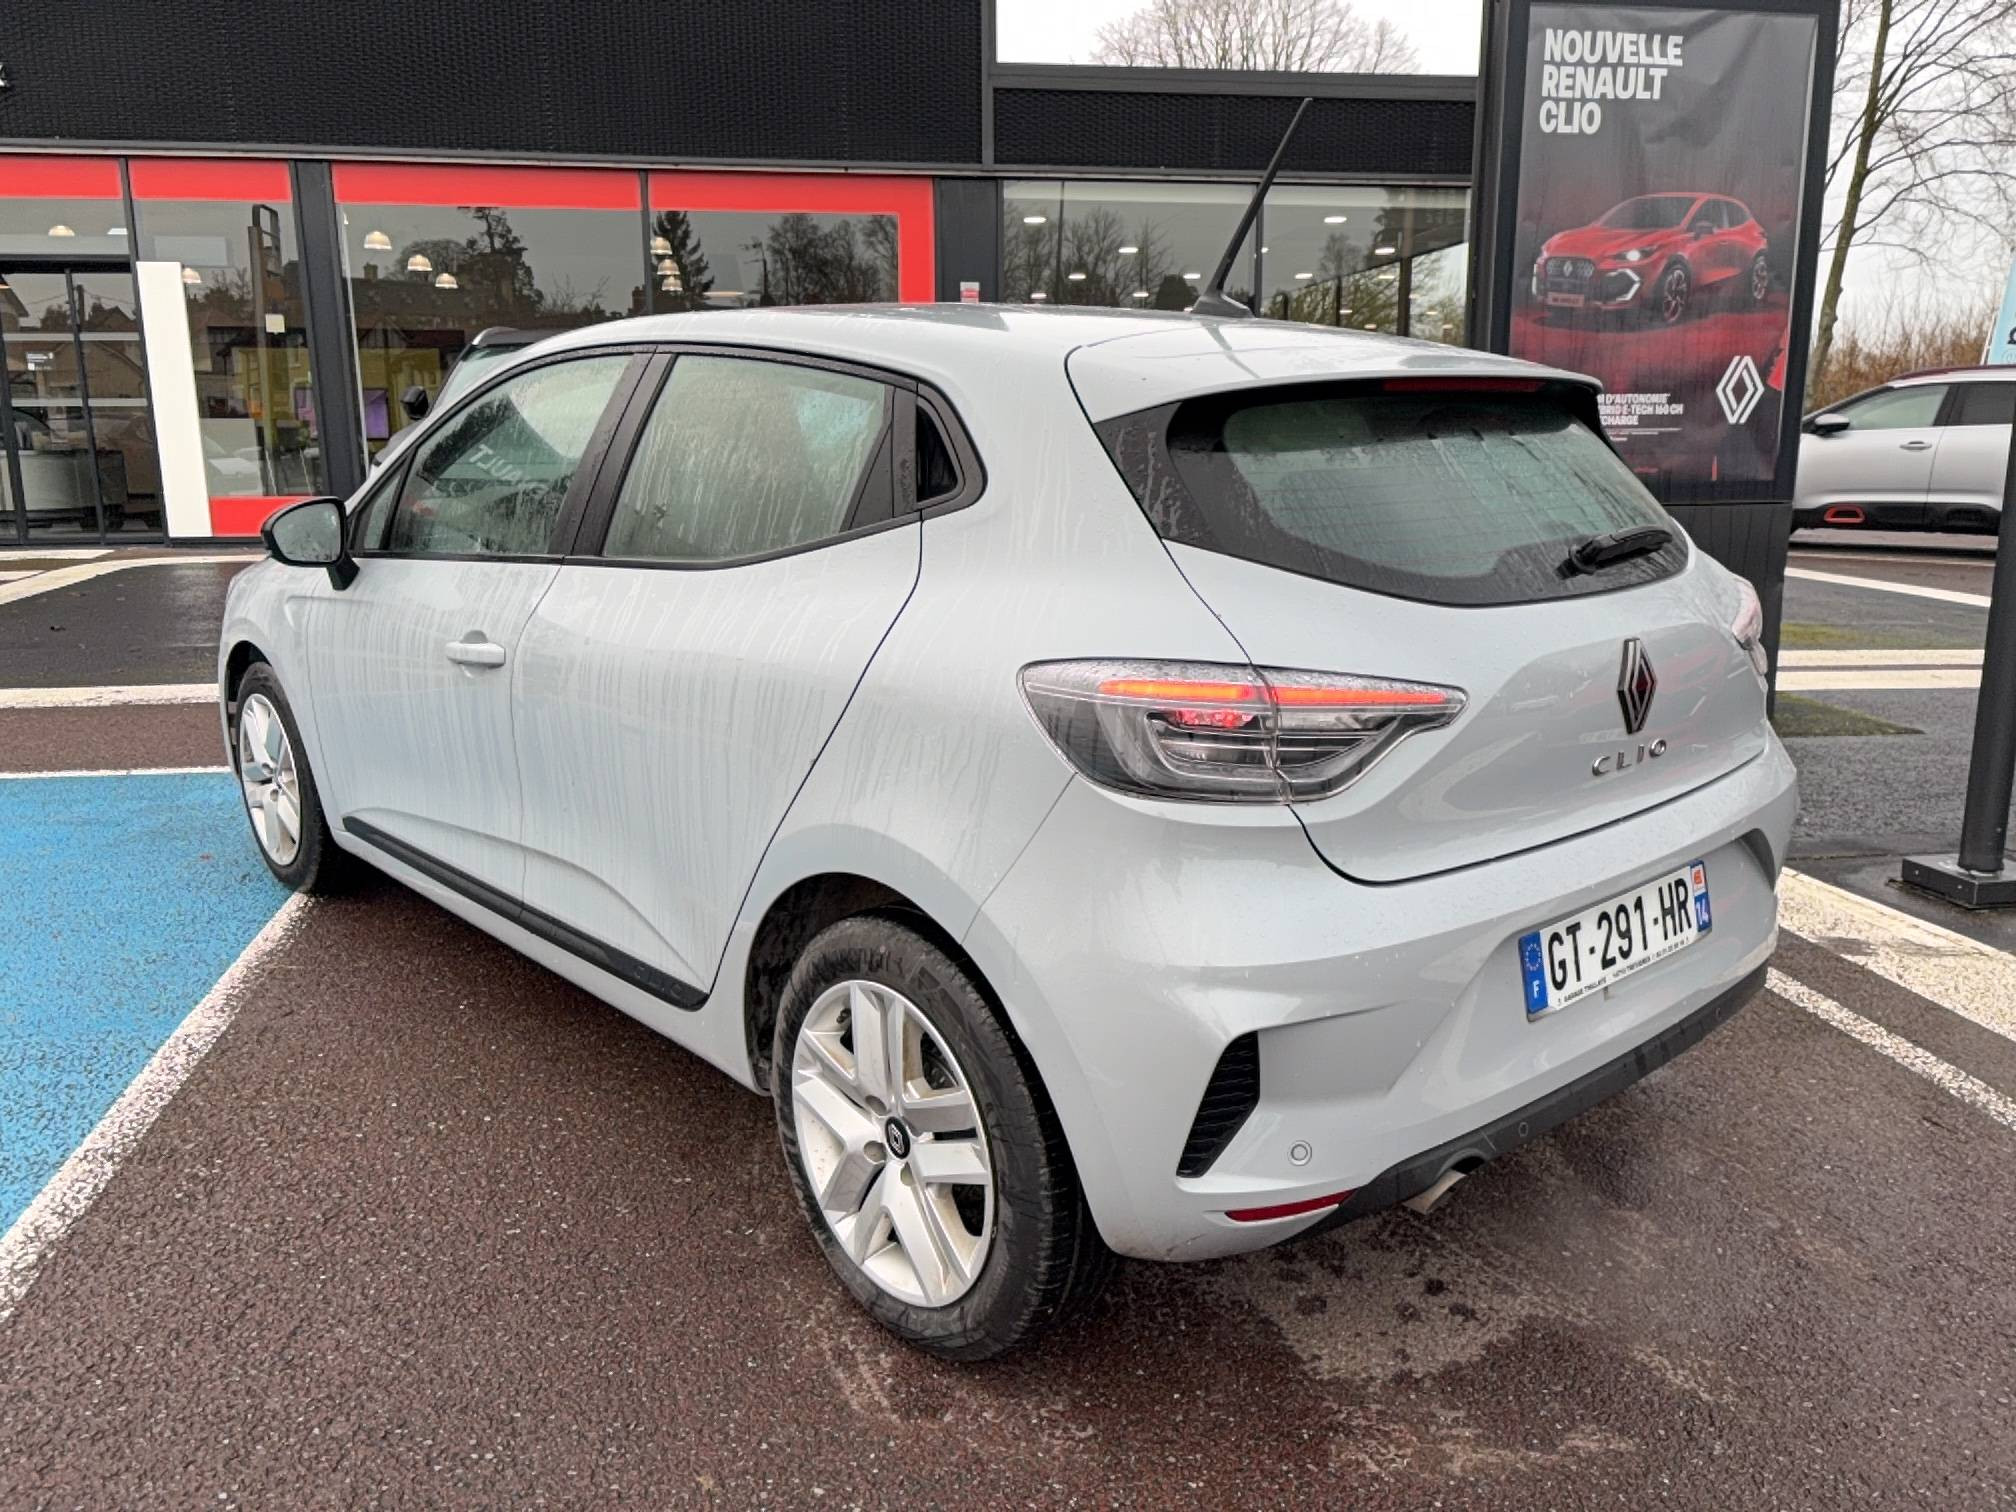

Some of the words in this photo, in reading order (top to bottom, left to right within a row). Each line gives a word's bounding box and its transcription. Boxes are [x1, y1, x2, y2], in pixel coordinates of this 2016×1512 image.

[1543, 28, 1683, 67] NOUVELLE
[1541, 65, 1668, 99] RENAULT
[1539, 100, 1601, 135] CLIO
[1598, 404, 1622, 415] BRID
[1599, 415, 1639, 425] CHARGE
[1591, 738, 1667, 777] CLIO
[1695, 898, 1710, 926] 14
[1547, 877, 1693, 992] GT-291-HR
[1532, 980, 1540, 999] F
